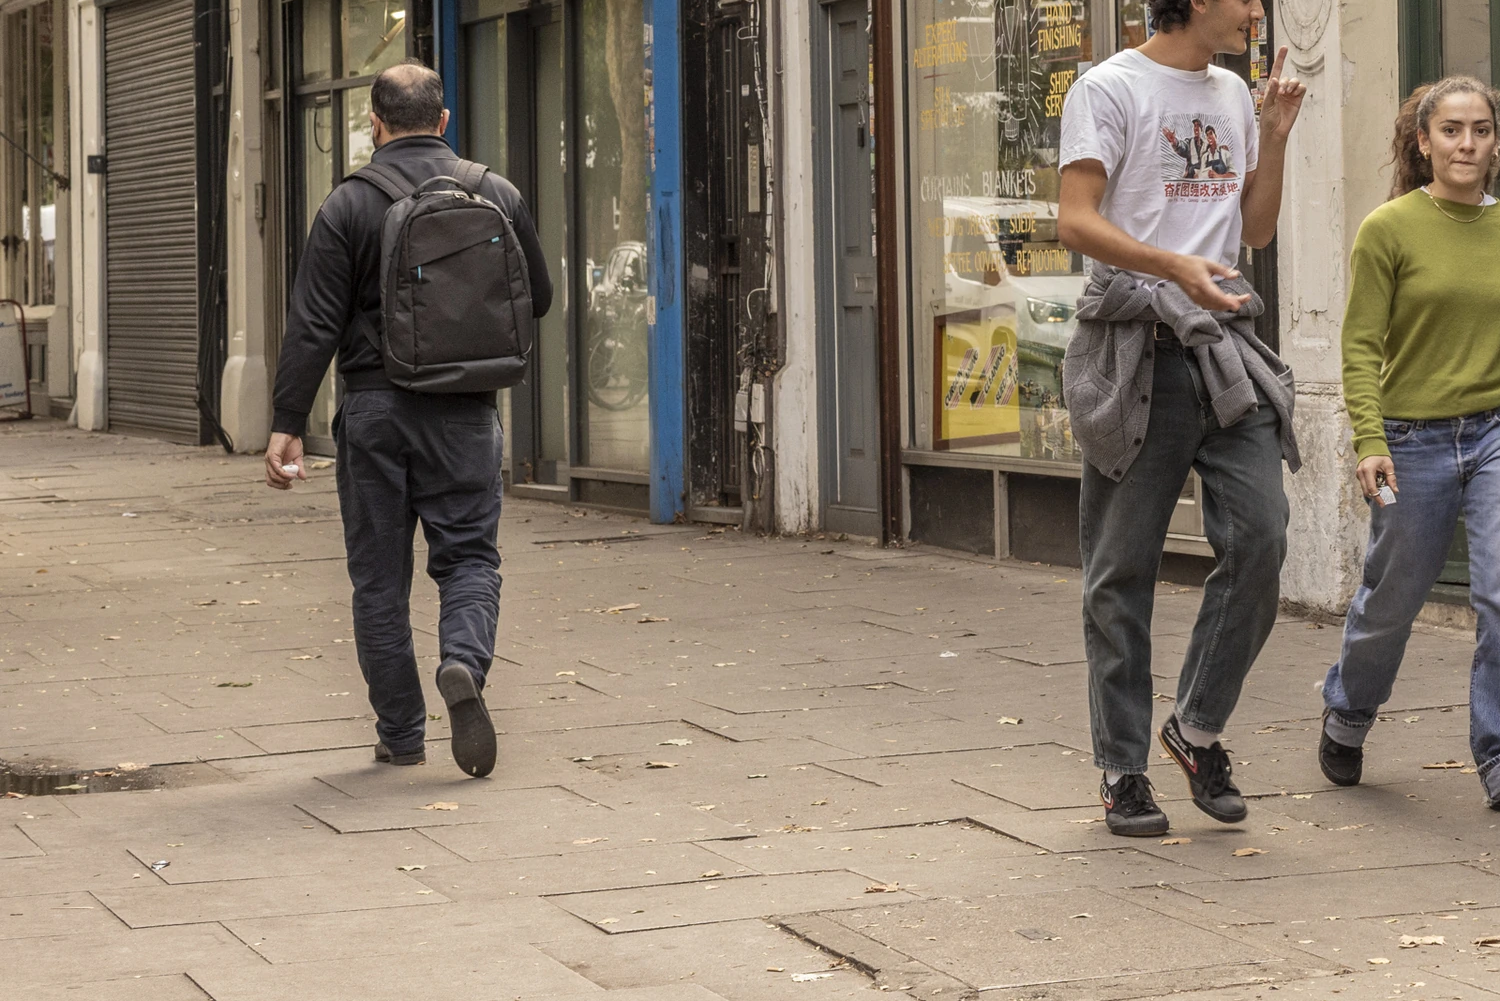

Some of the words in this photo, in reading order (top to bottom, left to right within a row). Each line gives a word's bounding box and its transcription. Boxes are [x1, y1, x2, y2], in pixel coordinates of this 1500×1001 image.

[1046, 2, 1073, 27] HAND
[925, 20, 957, 45] EXPERT
[1038, 24, 1082, 52] FINISHING
[913, 41, 968, 69] ALTERATIONS
[1050, 69, 1076, 95] SHIRT
[920, 172, 971, 202] CURTAINS
[982, 168, 1036, 198] BLANKETS
[1009, 211, 1037, 234] SUEDE
[1016, 248, 1069, 275] REPROOFING
[984, 345, 1005, 395] CLEANING
